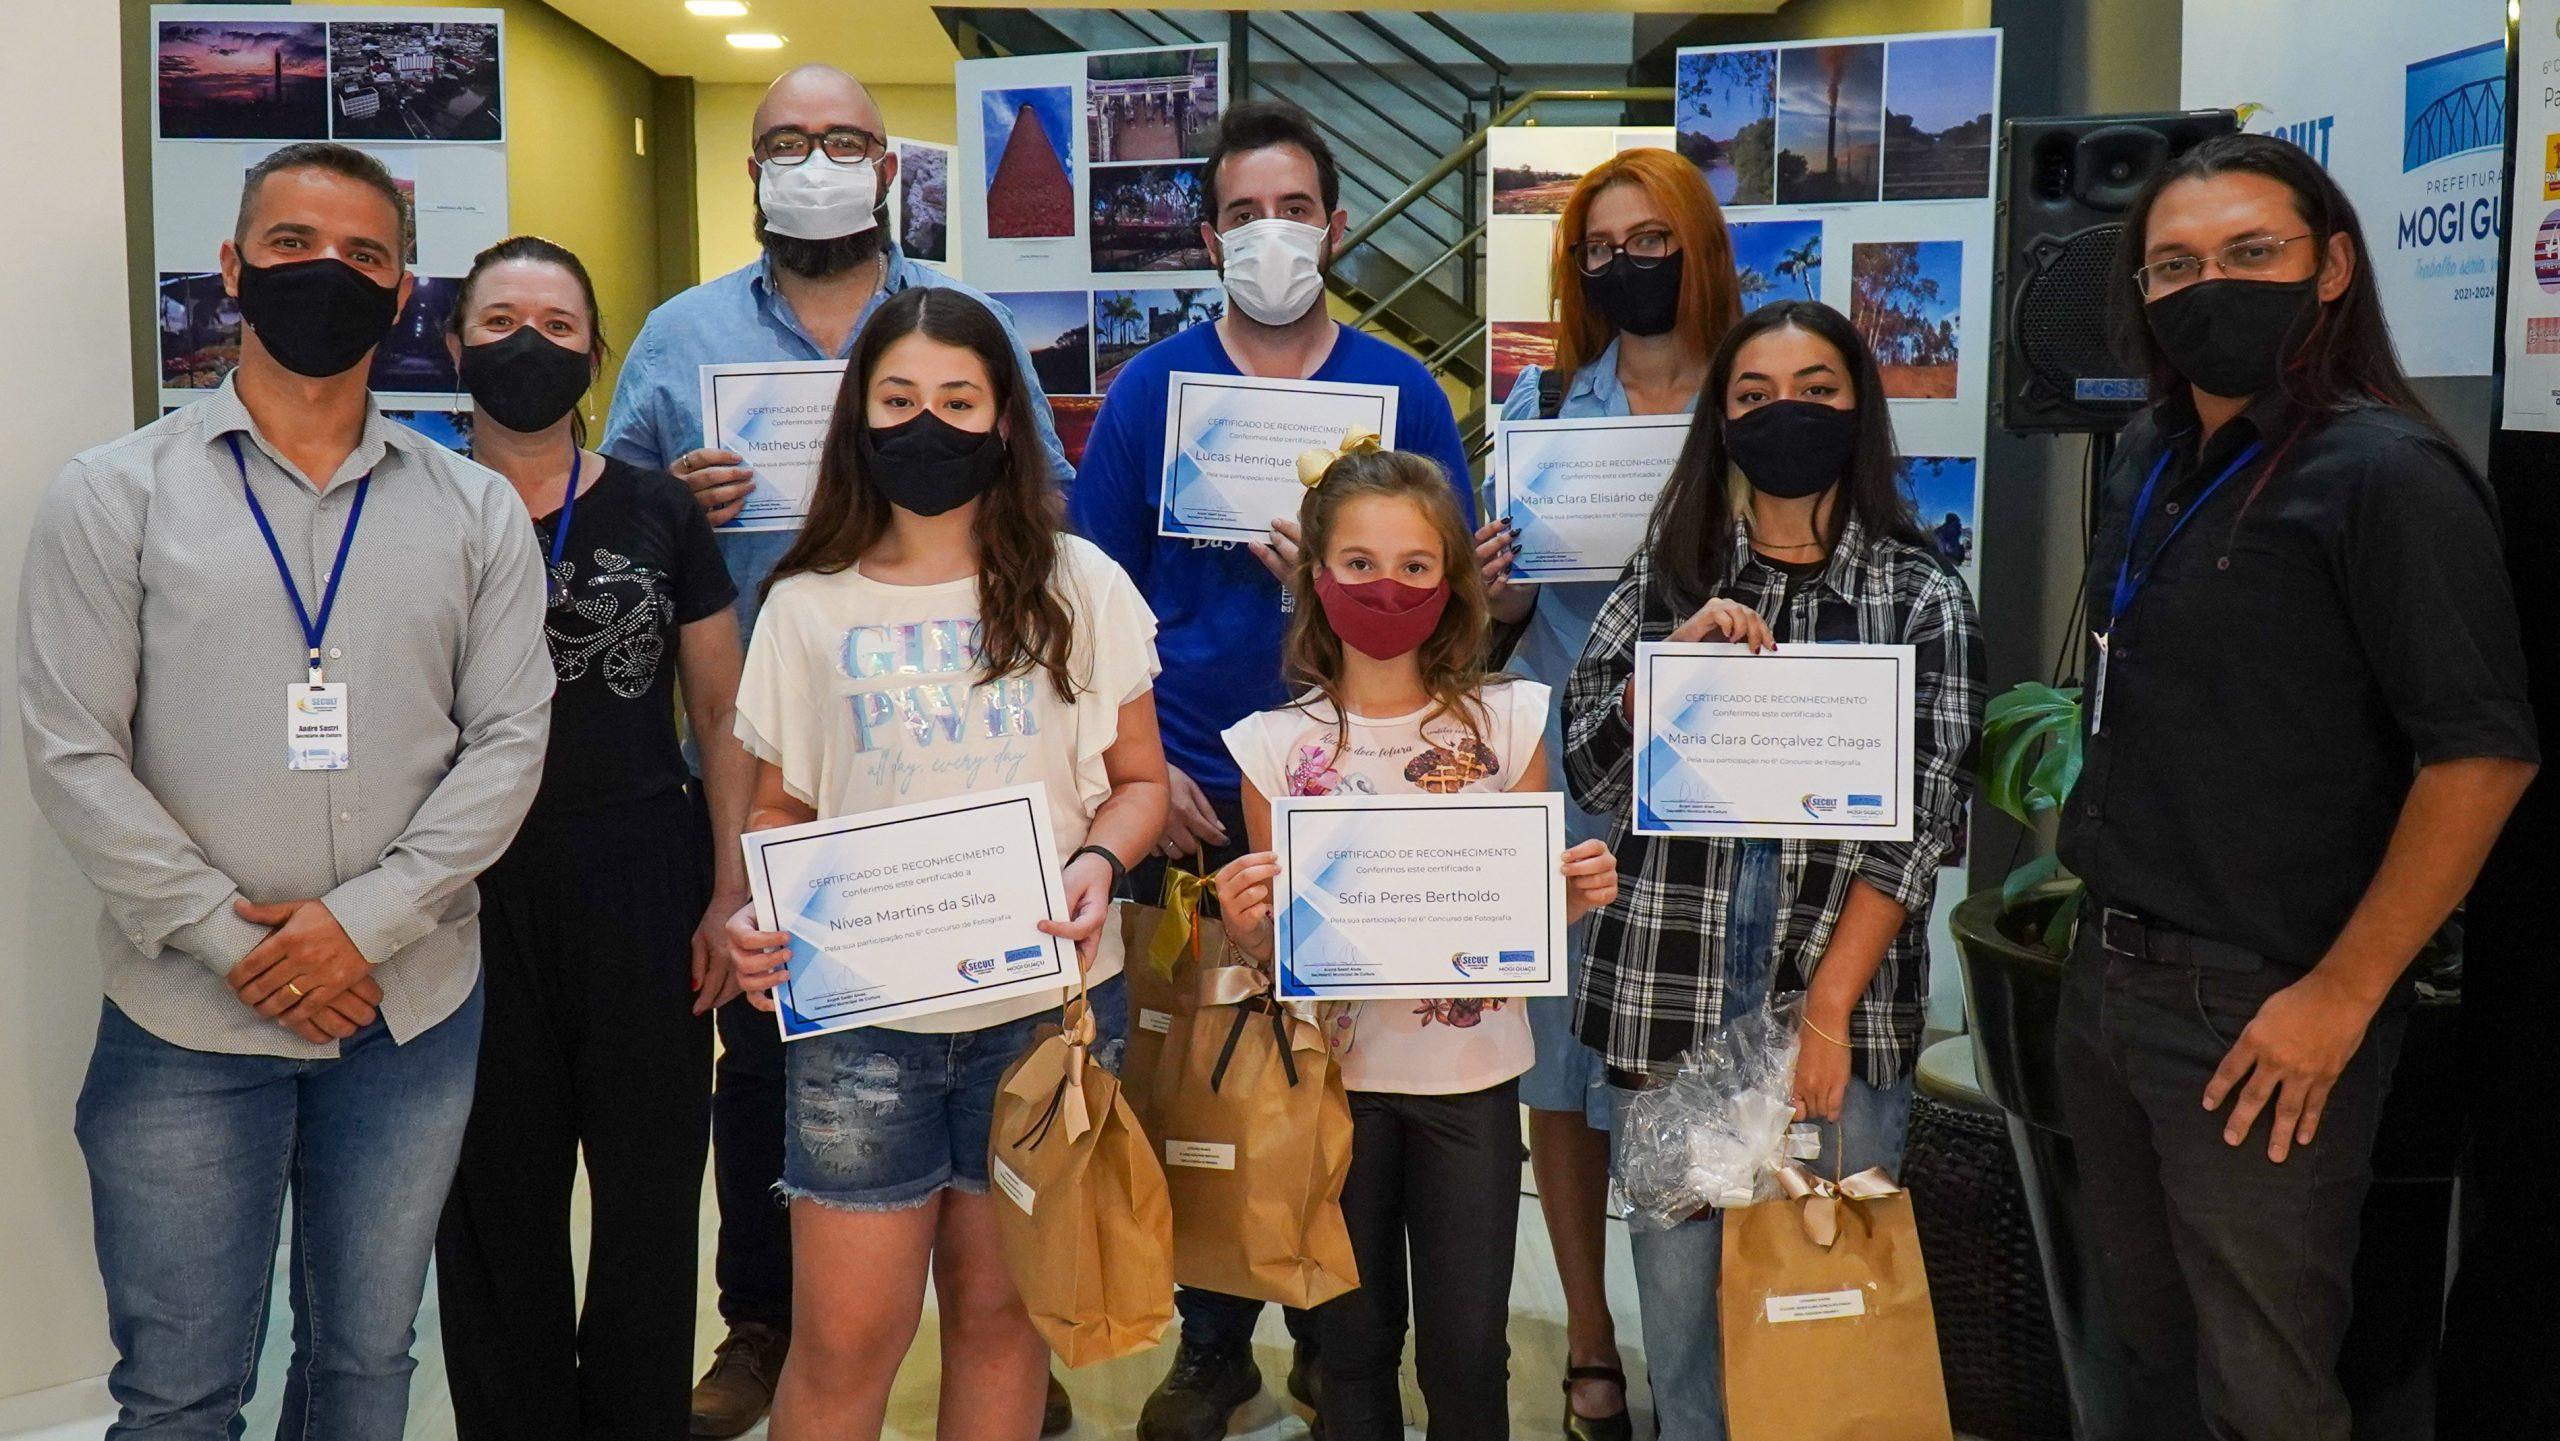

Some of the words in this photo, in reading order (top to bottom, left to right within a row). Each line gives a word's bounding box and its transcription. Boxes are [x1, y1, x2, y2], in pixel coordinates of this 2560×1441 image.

[2426, 170, 2503, 195] PREFEITURA
[2398, 201, 2465, 250] MOGI
[2454, 286, 2495, 301] 2021-2024
[747, 404, 805, 416] CERTIFICADO
[806, 404, 819, 414] DE
[771, 418, 813, 427] Conferimos
[1207, 418, 1262, 430] CERTIFICADO
[1263, 422, 1276, 431] DE
[1277, 423, 1350, 434] RECONHECIMENT
[748, 438, 806, 452] Matheus
[808, 437, 825, 450] de
[1229, 432, 1268, 442] Conferimos
[1284, 435, 1320, 445] certificado
[1195, 450, 1231, 463] Lucas
[1234, 452, 1292, 468] Henrique
[1537, 460, 1593, 471] CERTIFICADO
[1594, 459, 1608, 469] DE
[1609, 457, 1676, 468] RECONHECIMEN
[1560, 472, 1601, 481] Conferimos
[1618, 471, 1655, 480] certificado
[1520, 494, 1554, 506] Maria
[1556, 493, 1588, 505] Clara
[1590, 492, 1636, 504] Elisiário
[1638, 491, 1653, 502] de
[1685, 693, 1752, 704] CERTIFICADO
[1754, 694, 1768, 704] DE
[1770, 695, 1868, 705] RECONHECIMENTO
[1712, 709, 1761, 718] Conferimos
[1780, 710, 1826, 719] certificado
[1668, 733, 1707, 745] Maria
[1710, 733, 1747, 746] Clara
[1750, 734, 1823, 749] Gonçalvez
[1827, 735, 1882, 750] Chagas
[1812, 797, 1838, 807] SECULT
[1326, 849, 1397, 860] CERTIFICADO
[1399, 849, 1414, 859] DE
[1416, 847, 1517, 858] RECONHECIMENTO
[808, 868, 882, 890] CERTIFICADO
[883, 865, 899, 876] DE
[902, 845, 1005, 872] RECONHECIMENTO
[1356, 865, 1406, 874] Conferimos
[1427, 864, 1474, 873] certificado
[842, 883, 894, 899] Conferimos
[895, 879, 914, 889] este
[915, 870, 964, 886] certificado
[1339, 891, 1376, 905] Sofia
[1380, 891, 1422, 904] Peres
[1425, 890, 1501, 903] Bertholdo
[876, 903, 935, 923] Martins
[938, 899, 957, 913] da
[961, 891, 997, 909] Silva
[1361, 916, 1407, 926] participação
[1427, 914, 1462, 923] Concurso
[1474, 914, 1512, 924] Fotografia
[857, 933, 904, 949] participação
[925, 924, 961, 936] Concurso
[972, 913, 1012, 928] Fotografia
[968, 959, 995, 972] SECULT
[1462, 956, 1489, 965] SECULT
